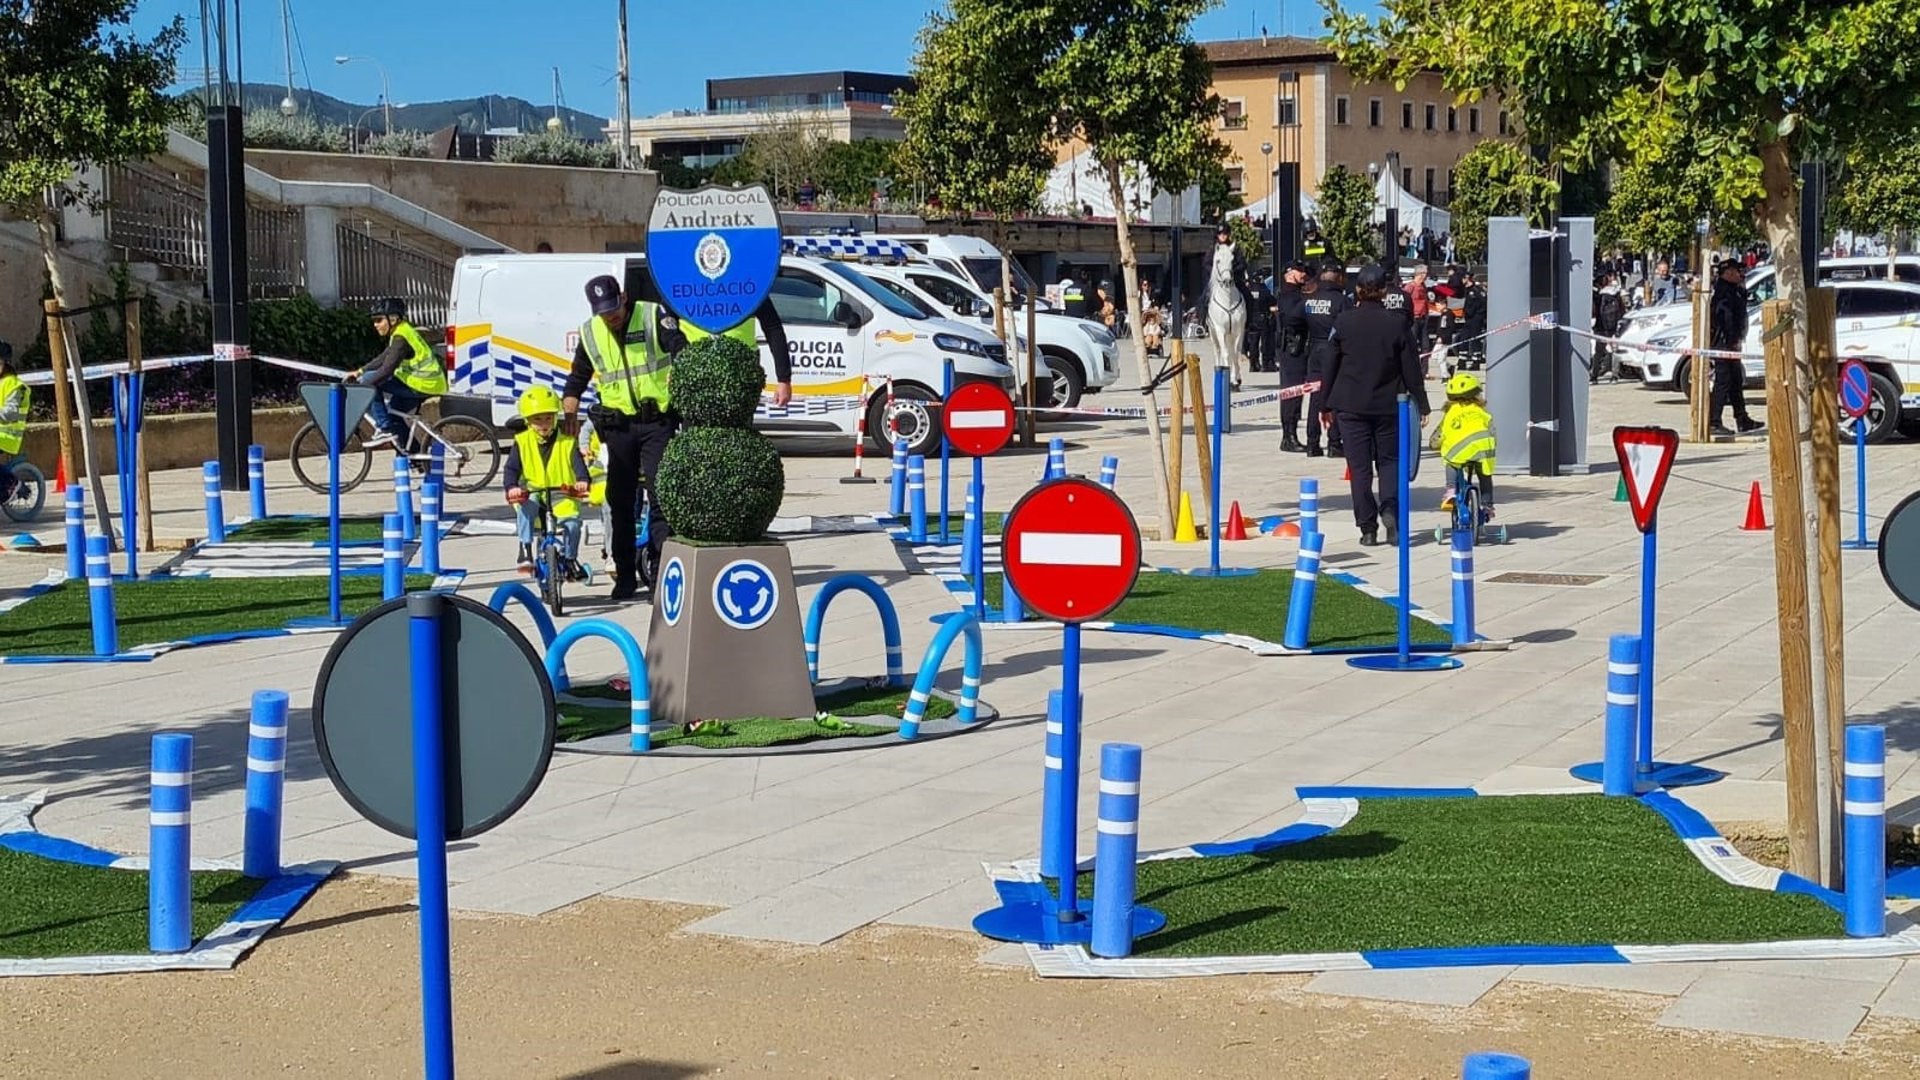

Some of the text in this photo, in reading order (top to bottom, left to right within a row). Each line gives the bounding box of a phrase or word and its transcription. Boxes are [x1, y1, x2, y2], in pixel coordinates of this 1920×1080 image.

[658, 193, 766, 207] POLICIA LOCAL
[664, 210, 755, 228] Andratx
[672, 279, 756, 298] EDUCACIÓ
[685, 300, 742, 318] VIÀRIA
[787, 340, 844, 354] OLICIA
[791, 355, 846, 368] LOCAL
